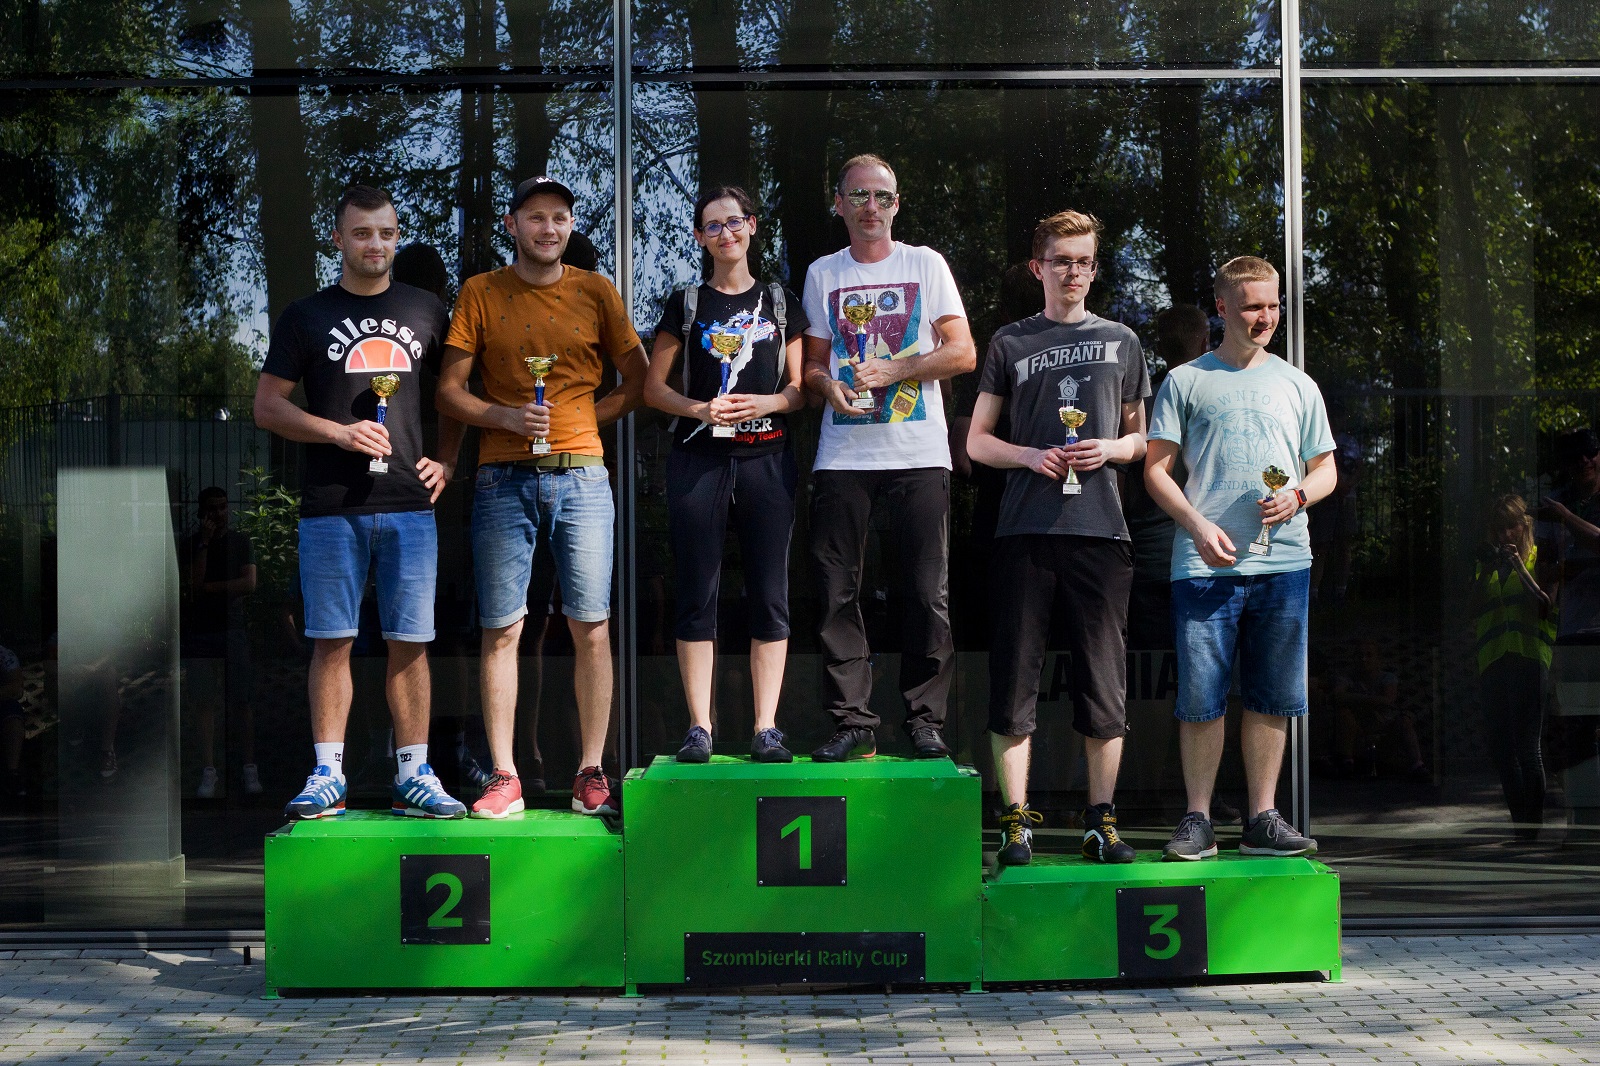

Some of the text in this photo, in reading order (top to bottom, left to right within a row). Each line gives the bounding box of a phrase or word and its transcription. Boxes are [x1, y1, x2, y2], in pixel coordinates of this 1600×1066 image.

[327, 317, 423, 362] ellesse
[1031, 345, 1104, 375] FAJRANT
[758, 429, 783, 441] Team
[780, 814, 812, 870] 1
[426, 872, 463, 928] 2
[1143, 904, 1181, 960] 3
[702, 949, 908, 969] Szombierki Rally Cup
